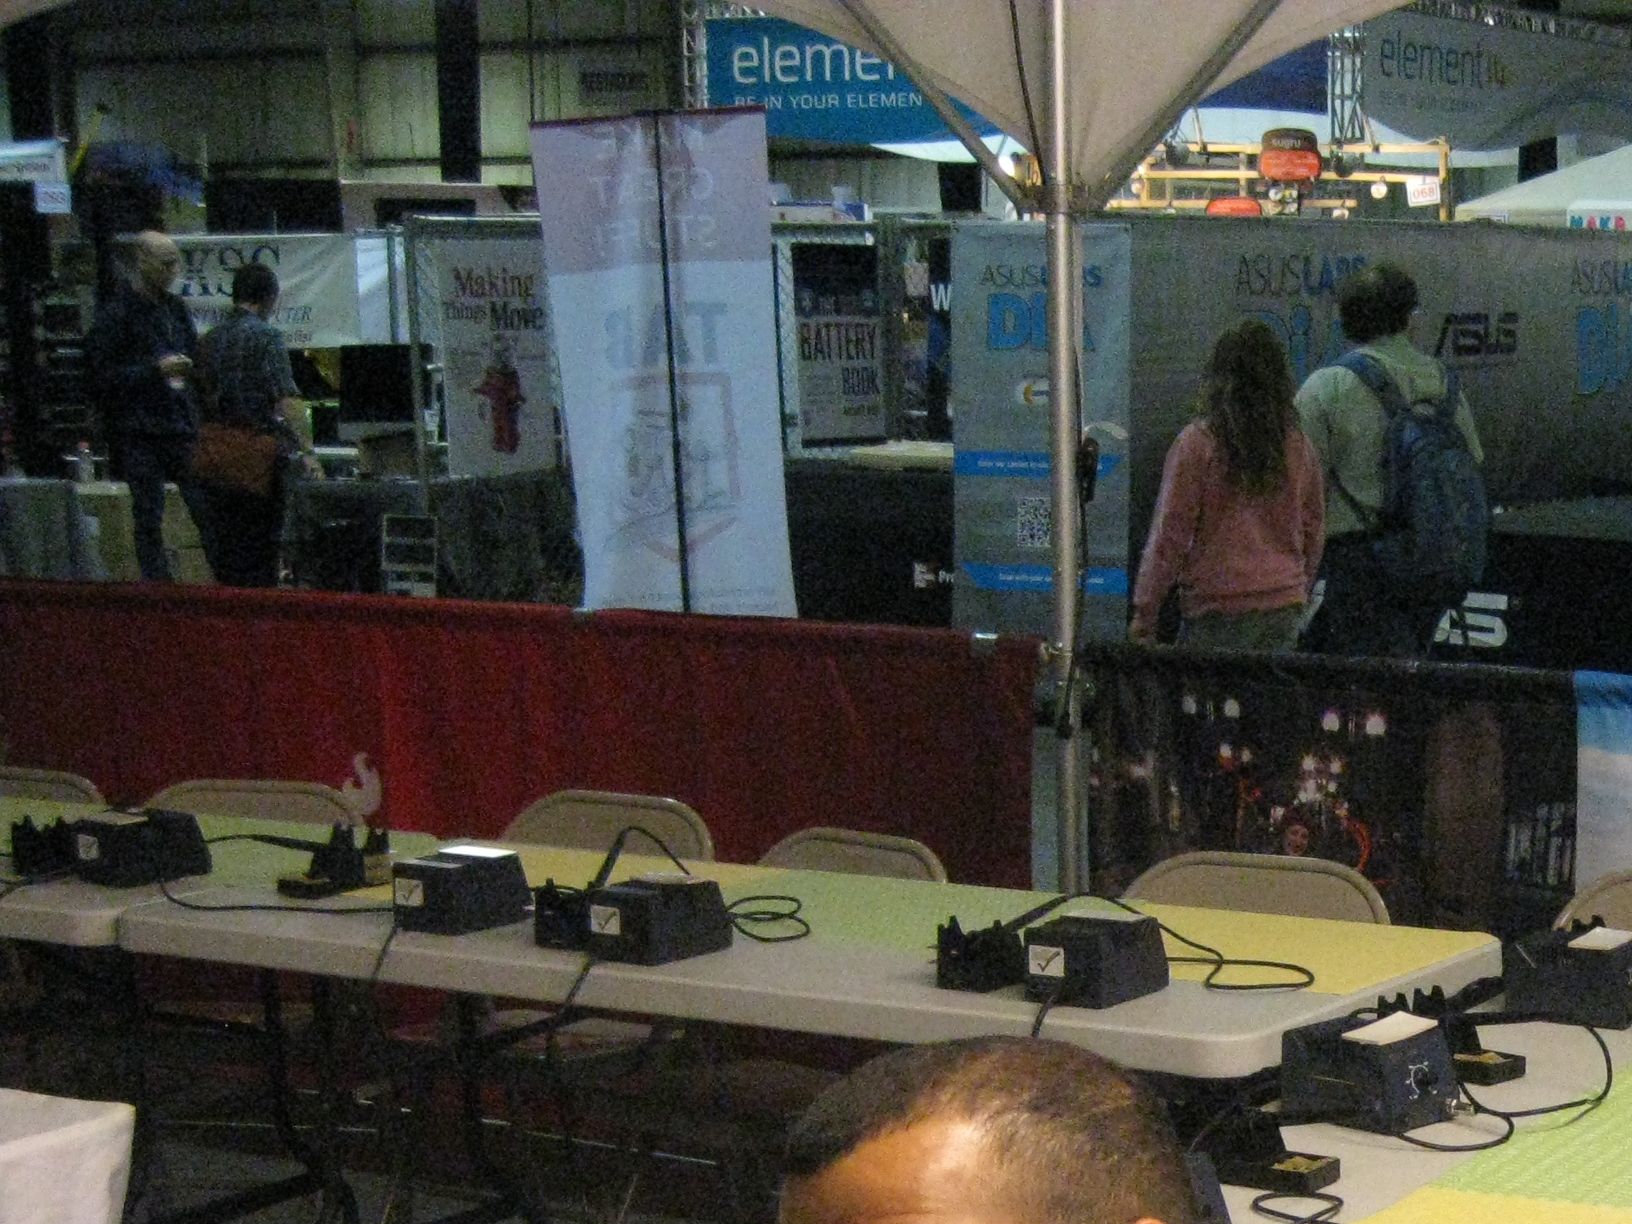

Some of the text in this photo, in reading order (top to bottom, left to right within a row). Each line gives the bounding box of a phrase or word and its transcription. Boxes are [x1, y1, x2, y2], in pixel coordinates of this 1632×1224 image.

[732, 37, 893, 84] eleme
[766, 96, 782, 109] IN
[790, 96, 839, 109] YOUR
[847, 93, 922, 108] ELEMEN
[1412, 187, 1435, 199] 068
[1569, 215, 1627, 232] MAKE
[453, 267, 536, 299] Making
[489, 300, 545, 331] Move
[800, 322, 878, 361] BATTERY
[842, 366, 881, 396] BOOK
